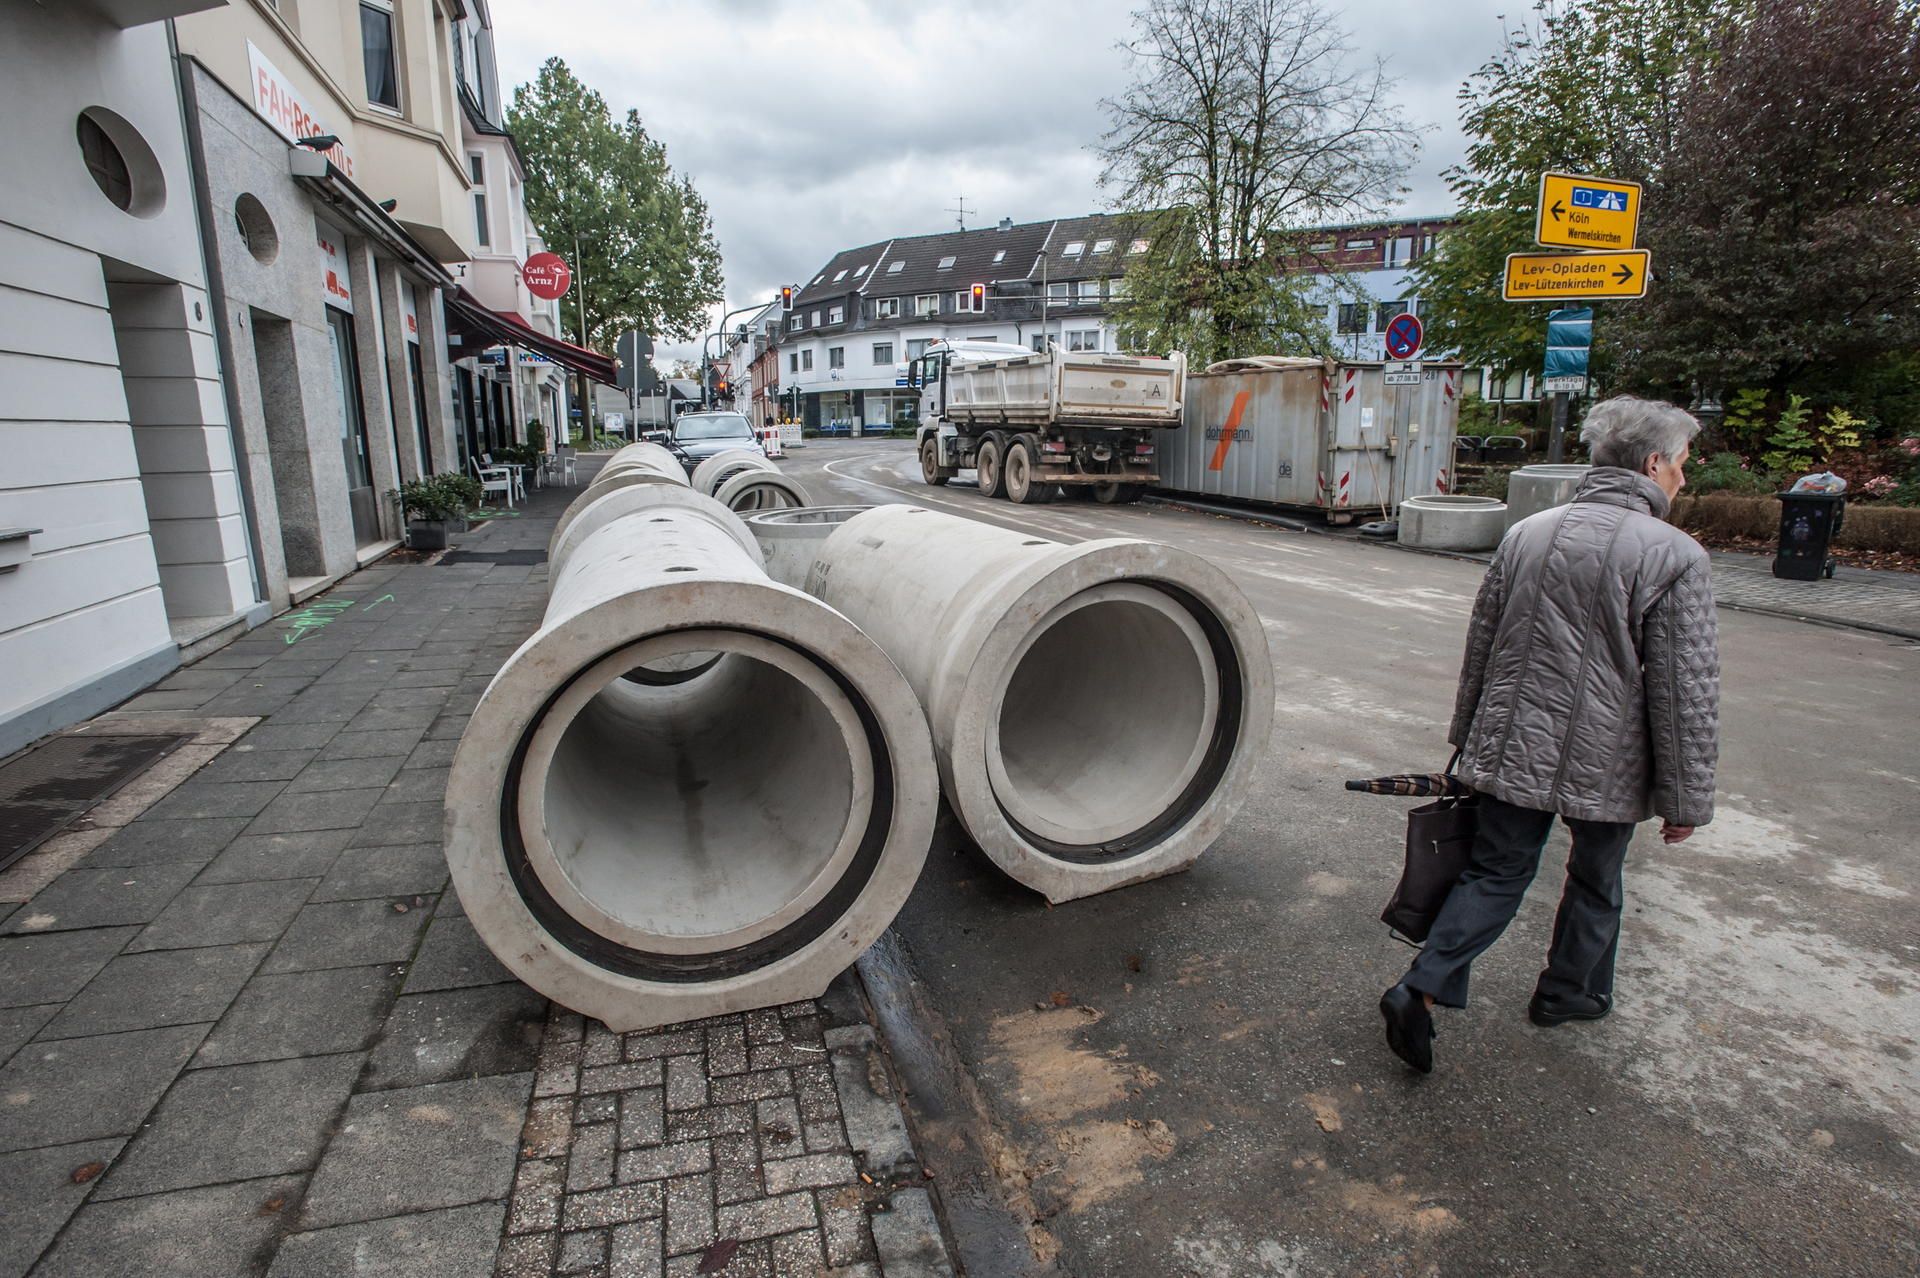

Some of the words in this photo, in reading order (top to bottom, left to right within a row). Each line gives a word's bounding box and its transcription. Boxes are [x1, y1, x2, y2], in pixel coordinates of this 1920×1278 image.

[1569, 211, 1590, 224] Köln
[1567, 227, 1622, 244] Wermelskirchen
[525, 266, 545, 275] Café
[1521, 262, 1606, 276] Lev-Opladen
[527, 276, 553, 286] Arnz
[1513, 278, 1605, 291] Lev-Lützenkirchen
[194, 301, 203, 322] 8
[1547, 376, 1583, 384] werktags
[1151, 383, 1161, 397] A
[1278, 462, 1292, 477] de
